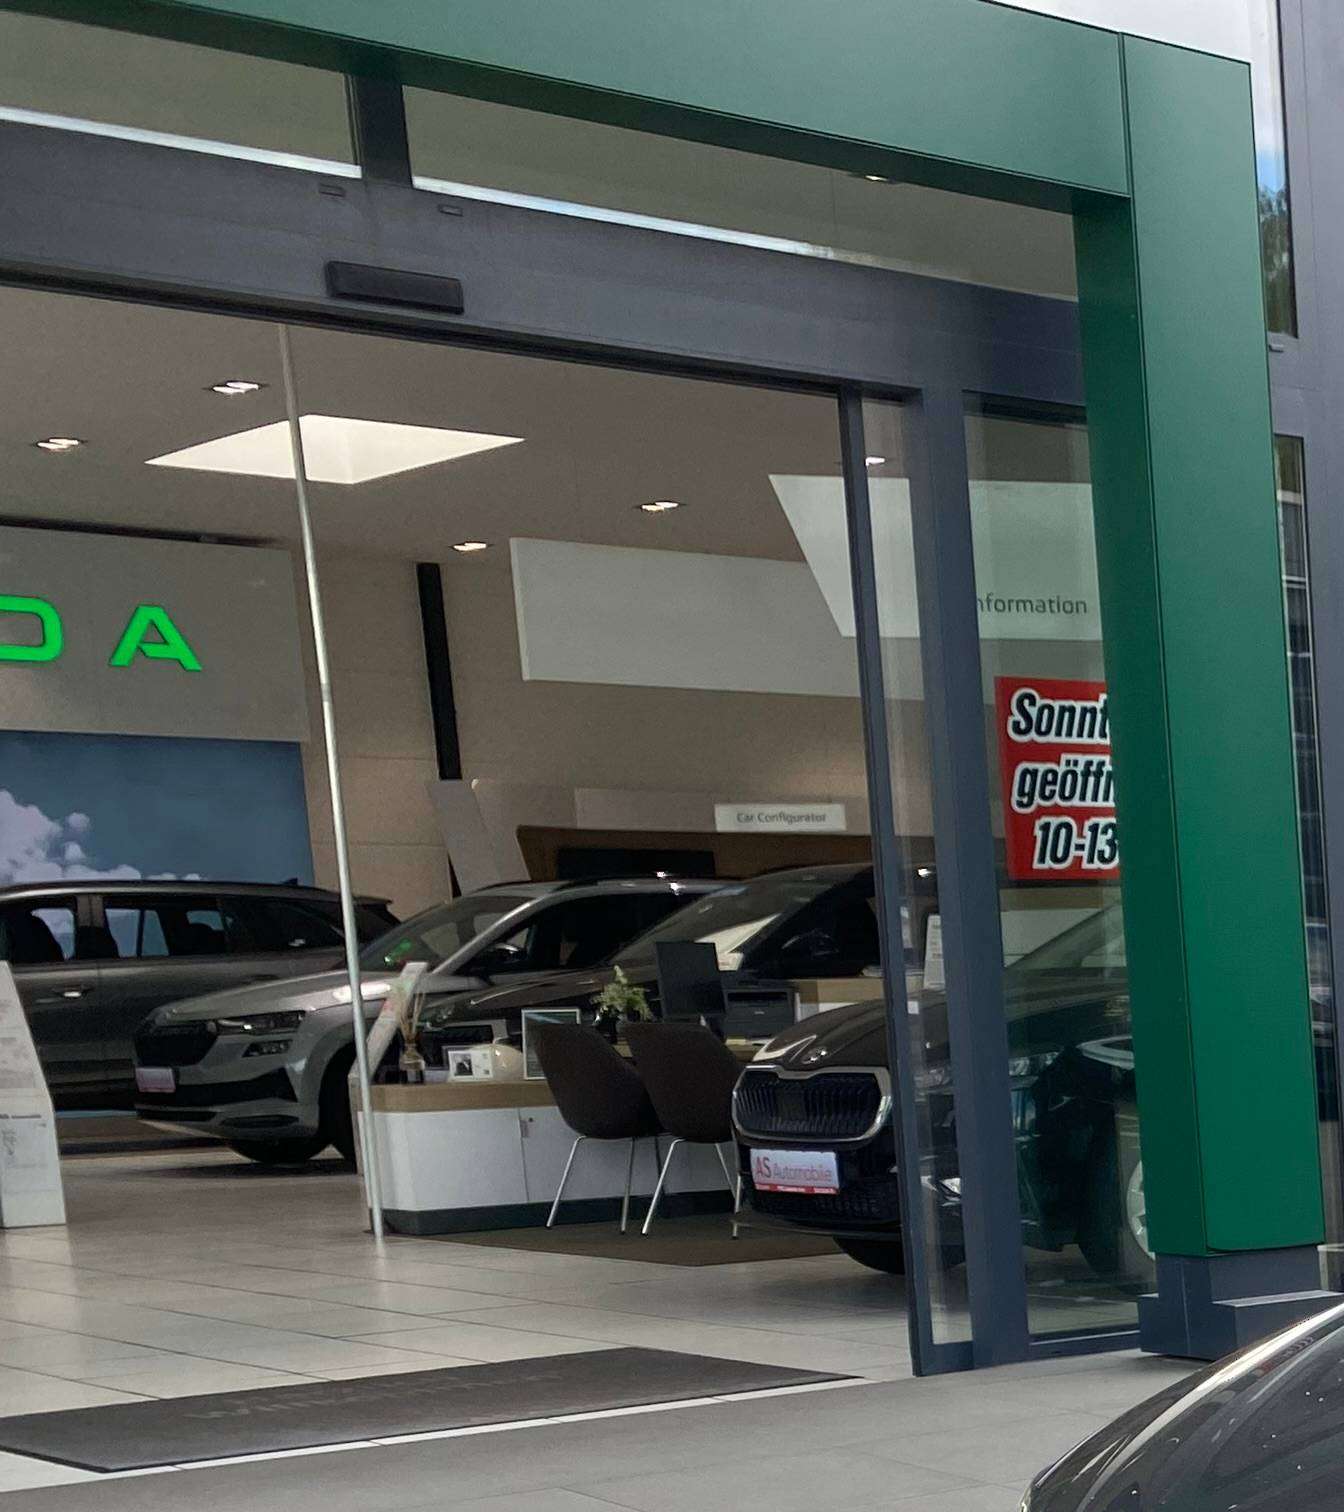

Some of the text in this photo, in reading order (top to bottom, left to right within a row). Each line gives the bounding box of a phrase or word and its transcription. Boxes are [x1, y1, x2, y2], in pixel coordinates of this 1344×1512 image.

[736, 811, 826, 824] Car Configurator
[755, 1156, 832, 1181] AS Automobile
